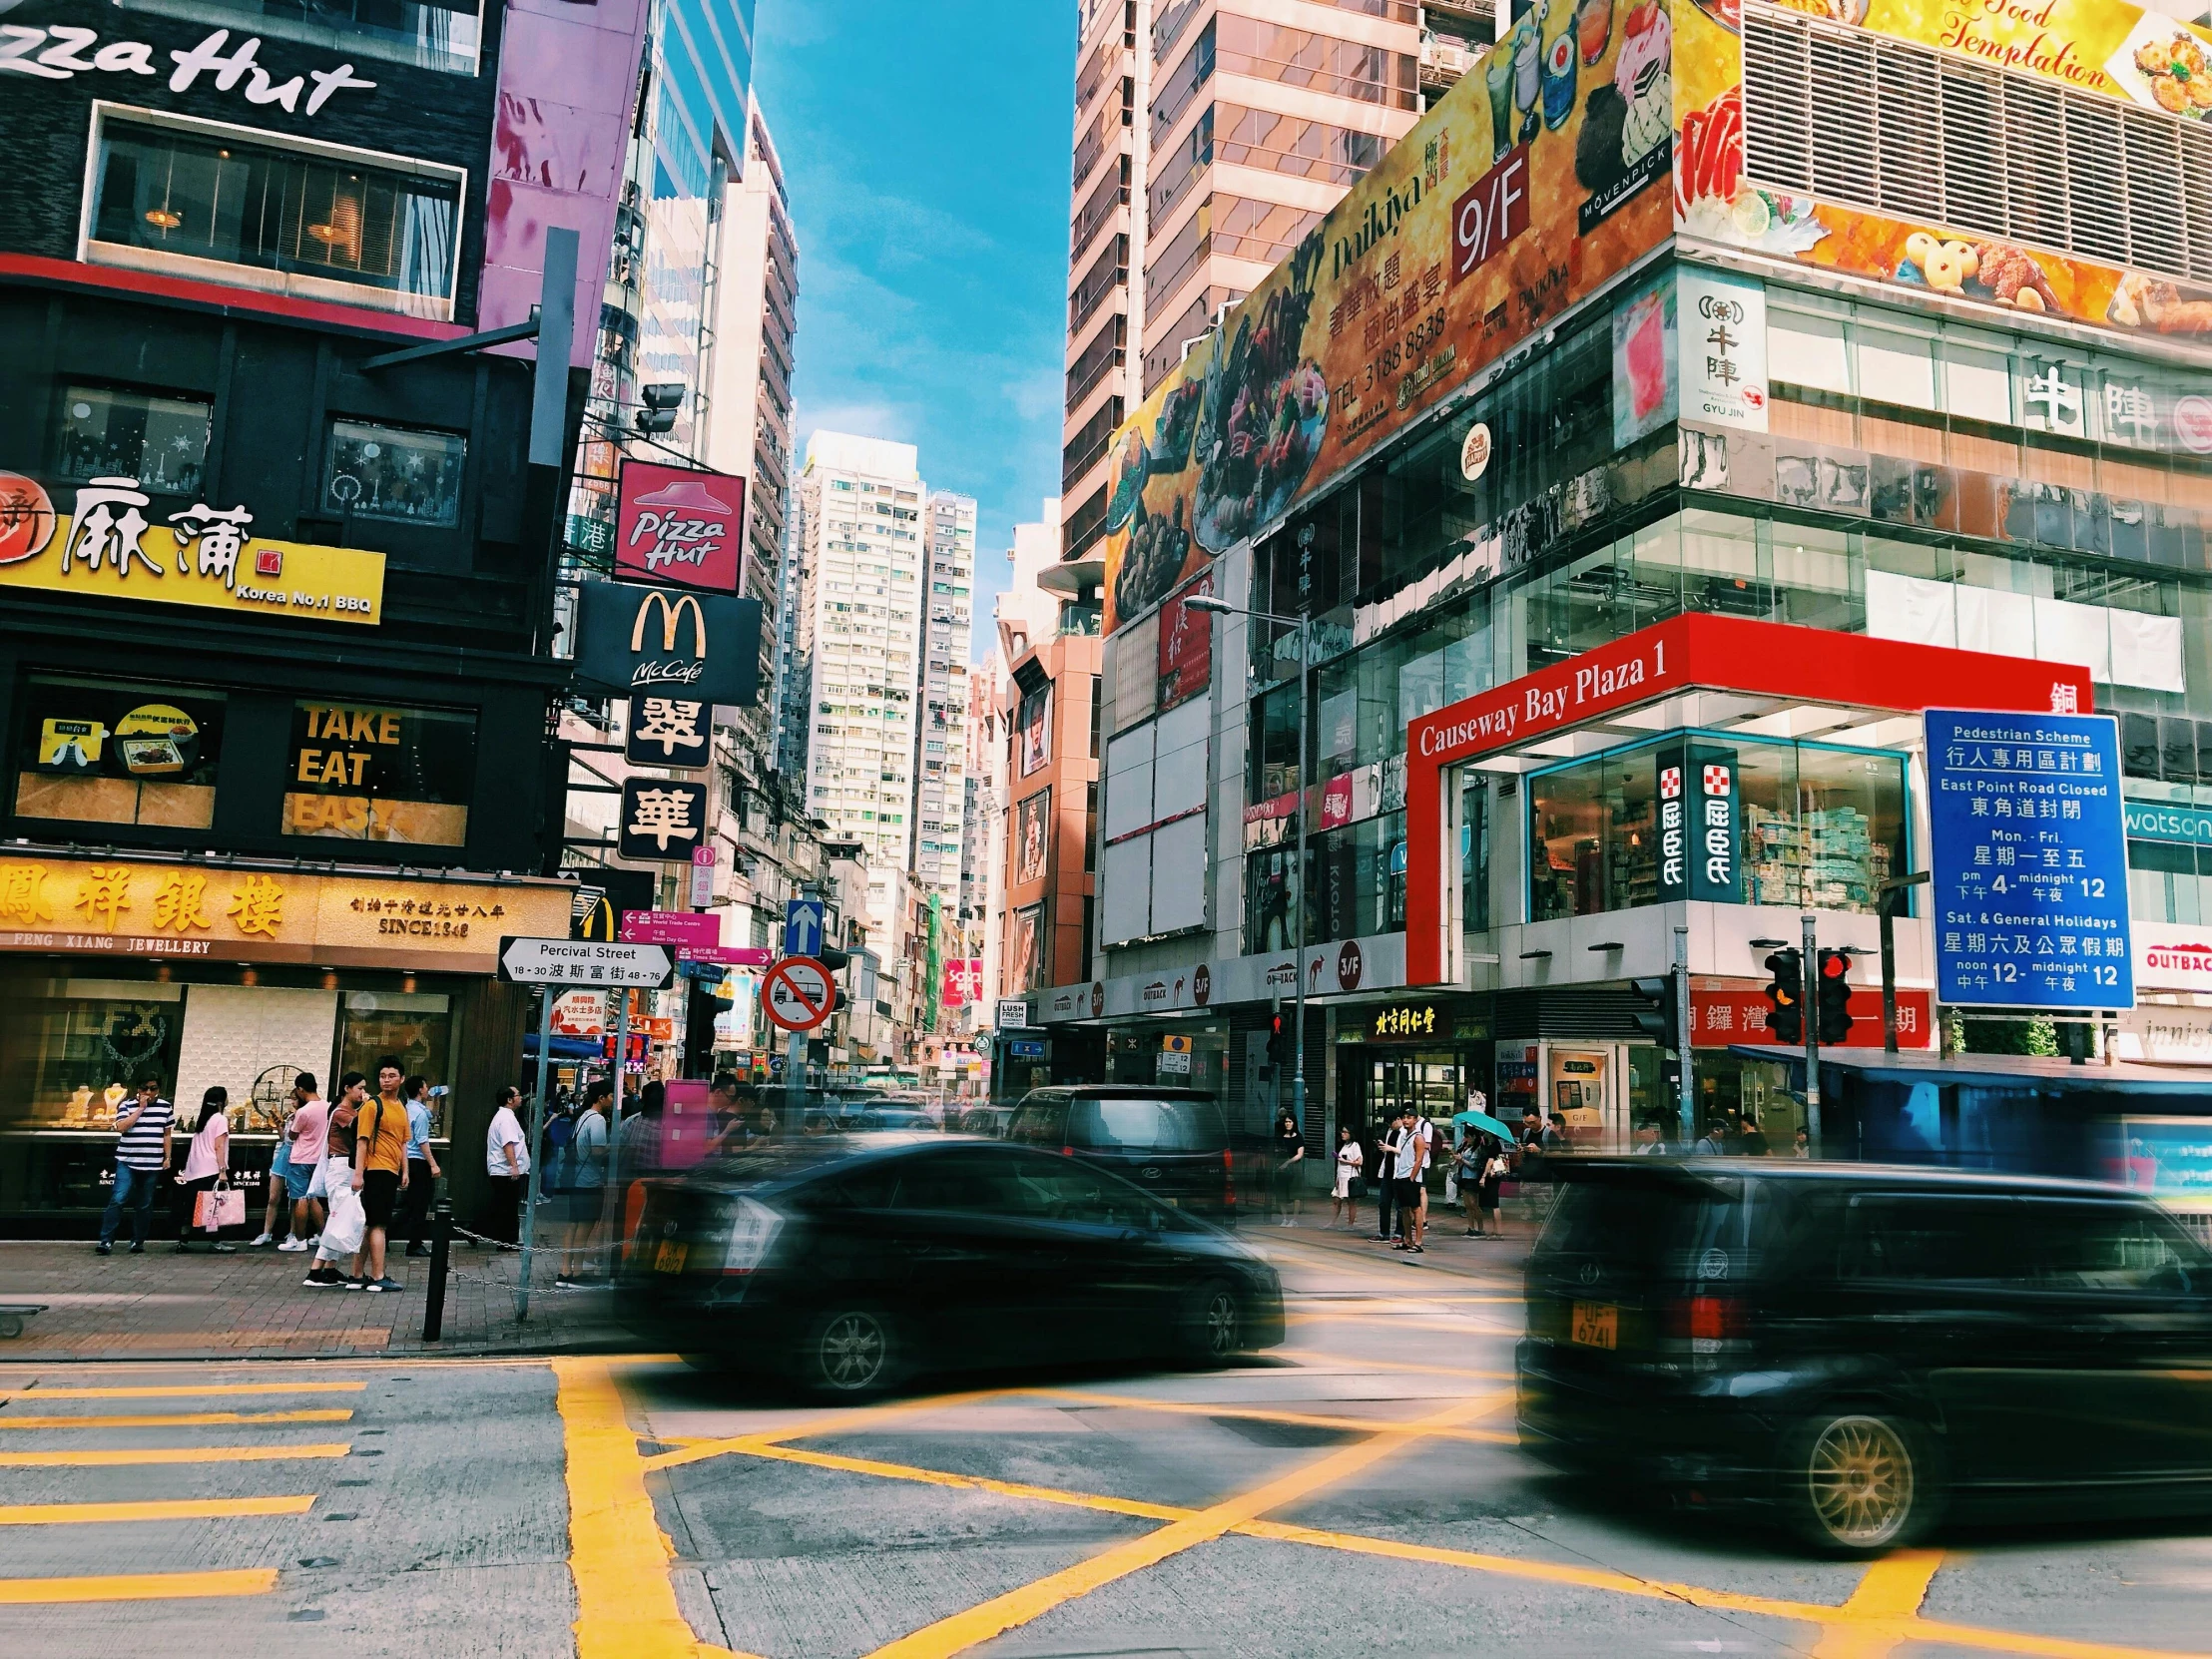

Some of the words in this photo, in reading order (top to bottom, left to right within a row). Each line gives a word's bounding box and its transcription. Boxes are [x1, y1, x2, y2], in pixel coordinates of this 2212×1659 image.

[1940, 11, 2109, 88] Temptation
[169, 29, 377, 116] Hut
[1333, 174, 1422, 281] Daikiya
[1458, 158, 1522, 275] 9/F
[1365, 341, 1401, 392] 3188
[1404, 306, 1445, 360] 8838
[1706, 324, 1741, 387] 牛陣
[1703, 403, 1726, 415] GYU
[1728, 408, 1744, 418] JIN
[629, 510, 727, 546] Pizza
[645, 540, 721, 570] Hut
[236, 585, 287, 604] Korea
[291, 590, 329, 608] No.1
[335, 596, 372, 613] BBQ
[631, 659, 704, 686] McCafé
[1419, 703, 1520, 757] Causeway
[1524, 681, 1569, 723] Bay
[1575, 657, 1645, 705] Plaza
[1653, 640, 1667, 677] 1
[302, 706, 401, 745] TAKE
[1953, 726, 2031, 742] Pedestrian
[2035, 731, 2091, 746] Scheme
[297, 749, 371, 786] EAT
[1945, 746, 2102, 773] 行人專用區計劃
[1940, 779, 1973, 792] East
[1977, 781, 2015, 794] Point
[2019, 782, 2054, 796] Road
[2058, 783, 2107, 797] Closed
[293, 794, 401, 832] EASY
[1970, 797, 2082, 820] 東角道封閉
[1991, 830, 2027, 842] Mon.
[2039, 832, 2063, 844] Fri.
[1973, 845, 2086, 868] 星期一至五
[1955, 885, 1987, 900] 下午
[2032, 887, 2063, 902] 午夜
[2080, 878, 2105, 897] 12
[1962, 871, 1980, 881] pm
[2018, 873, 2075, 885] midnight
[0, 863, 284, 937] 鳳祥銀樓
[1946, 911, 1976, 924] Sat.
[1980, 912, 1989, 924] &
[1993, 912, 2050, 926] General
[2054, 914, 2117, 930] Holidays
[14, 932, 53, 946] FENG
[65, 934, 114, 949] XIANG
[126, 938, 211, 954] JEWELLERY
[540, 944, 591, 958] Percival
[596, 946, 637, 960] Street
[1943, 933, 2125, 957] 星期六及公眾假期
[549, 963, 626, 980] 波斯富街
[1341, 956, 1359, 976] 3/F
[1956, 960, 1987, 970] noon
[2032, 961, 2088, 974] midnight
[1957, 974, 1989, 990] 中午
[2044, 976, 2076, 992] 午夜
[2092, 966, 2118, 986] 12
[1144, 989, 1167, 1001] OUTBACK
[1196, 978, 1209, 994] 3/F
[1376, 1005, 1435, 1036] 北京同仁堂
